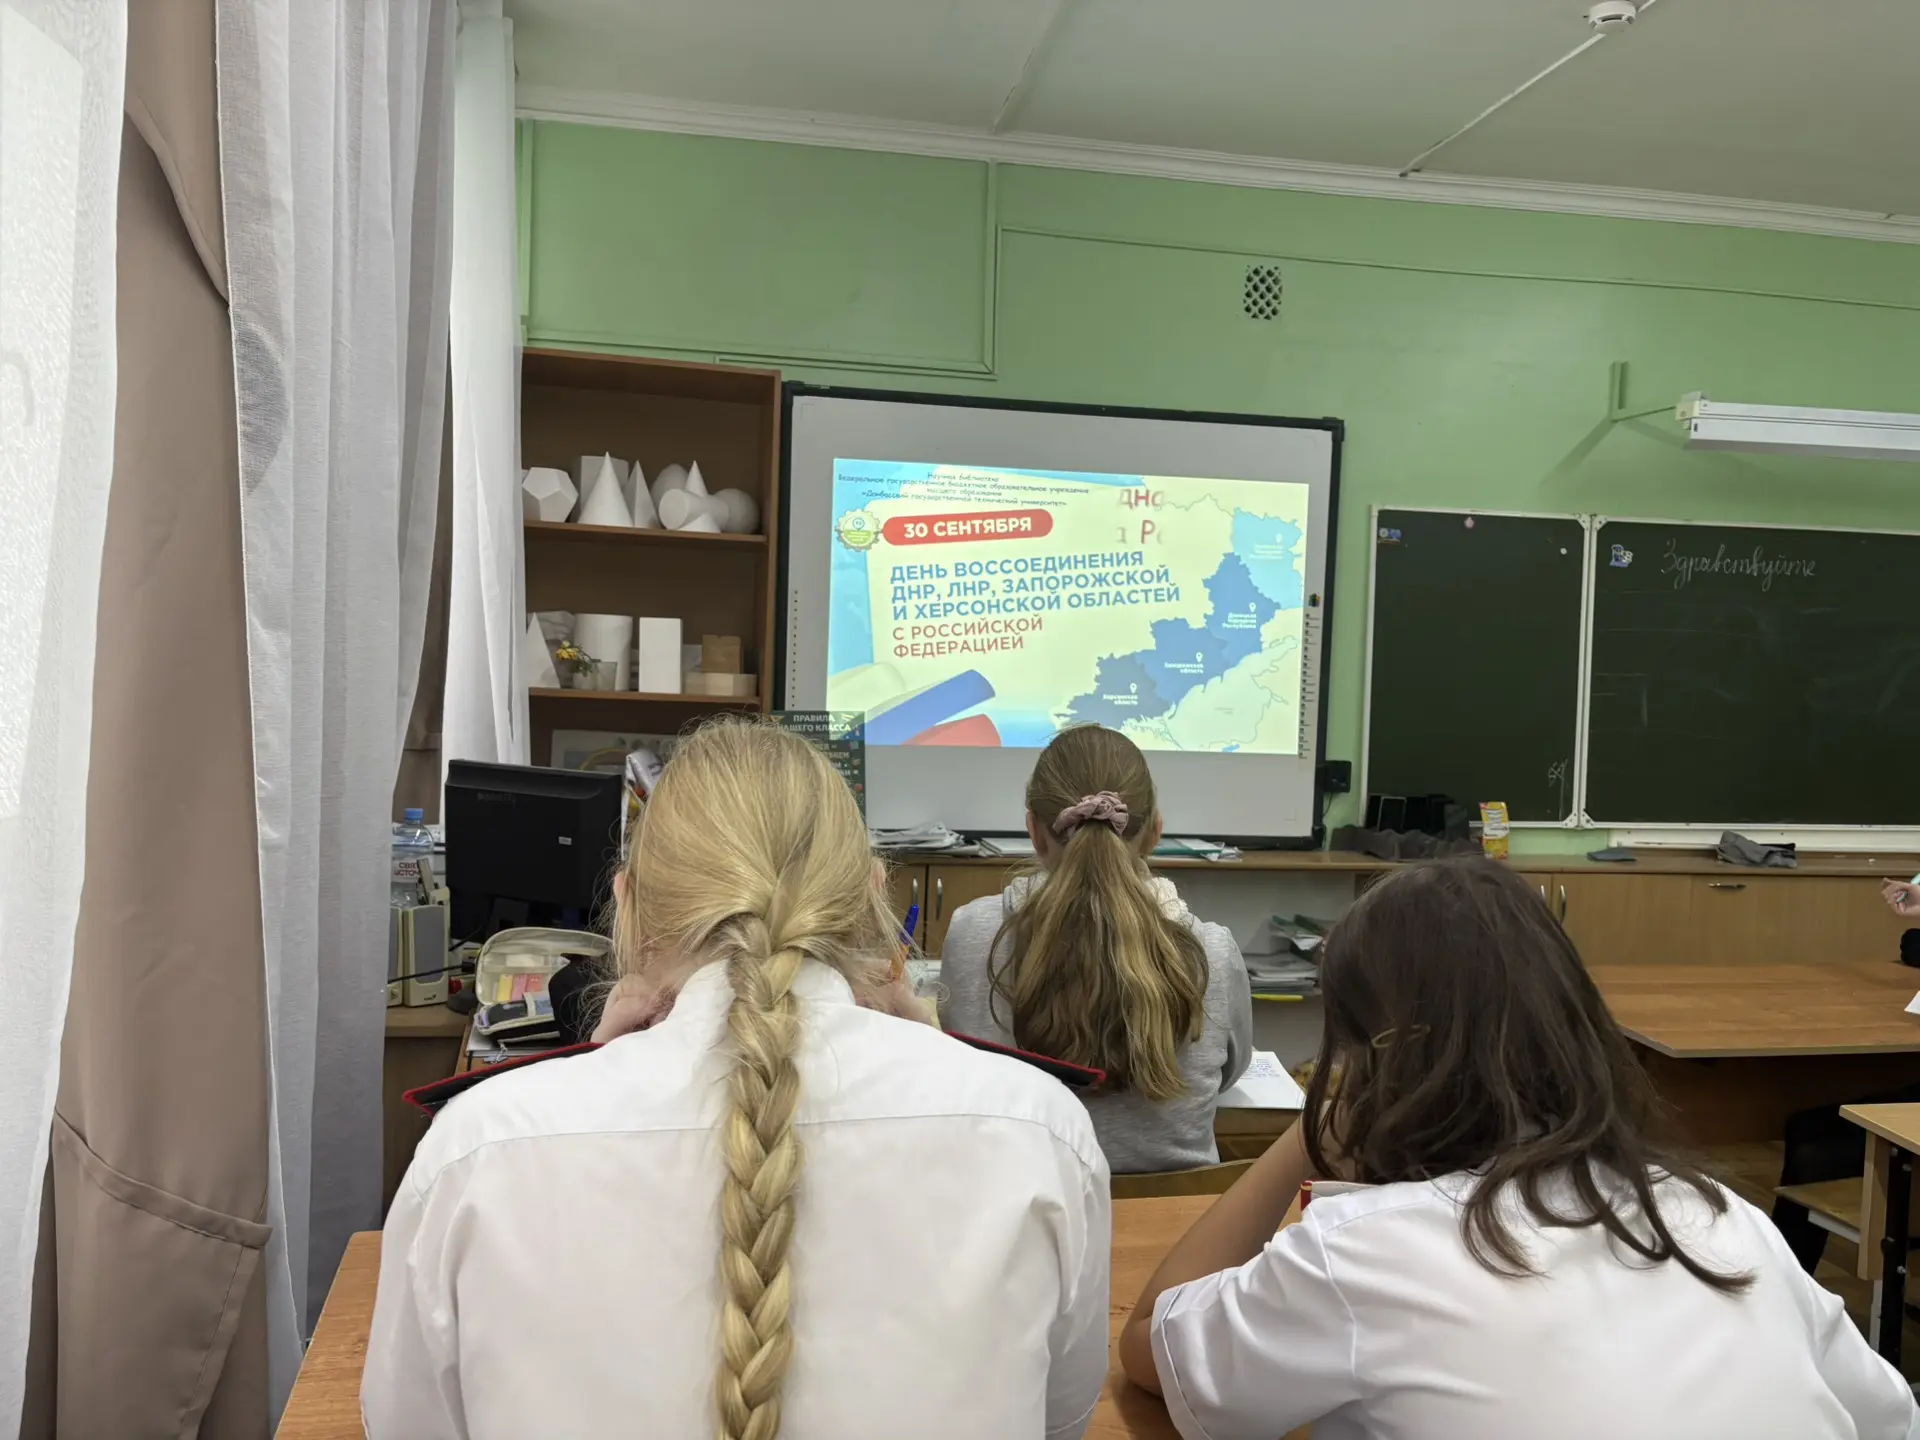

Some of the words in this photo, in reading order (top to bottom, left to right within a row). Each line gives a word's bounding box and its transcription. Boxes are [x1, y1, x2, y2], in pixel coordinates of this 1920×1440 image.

[903, 522, 928, 539] 30
[933, 516, 1033, 537] СЕНТЯБРЯ
[890, 563, 948, 584] ДЕНЬ
[954, 550, 1144, 578] ВОССОЕДИНЕНИЯ
[891, 583, 942, 604] ДНР,
[947, 580, 996, 598] ЛНР,
[1002, 564, 1170, 594] ЗАПОРОЖСКОЙ
[892, 604, 908, 621] И
[915, 590, 1062, 619] ХЕРСОНСКОЙ
[1068, 581, 1180, 608] ОБЛАСТЕЙ
[892, 626, 905, 641] С
[911, 613, 1043, 640] РОССИЙСКОЙ
[893, 632, 1024, 659] ФЕДЕРАЦИЕЙ
[793, 714, 836, 723] ПРАВИЛА
[815, 723, 852, 732] КЛАССА
